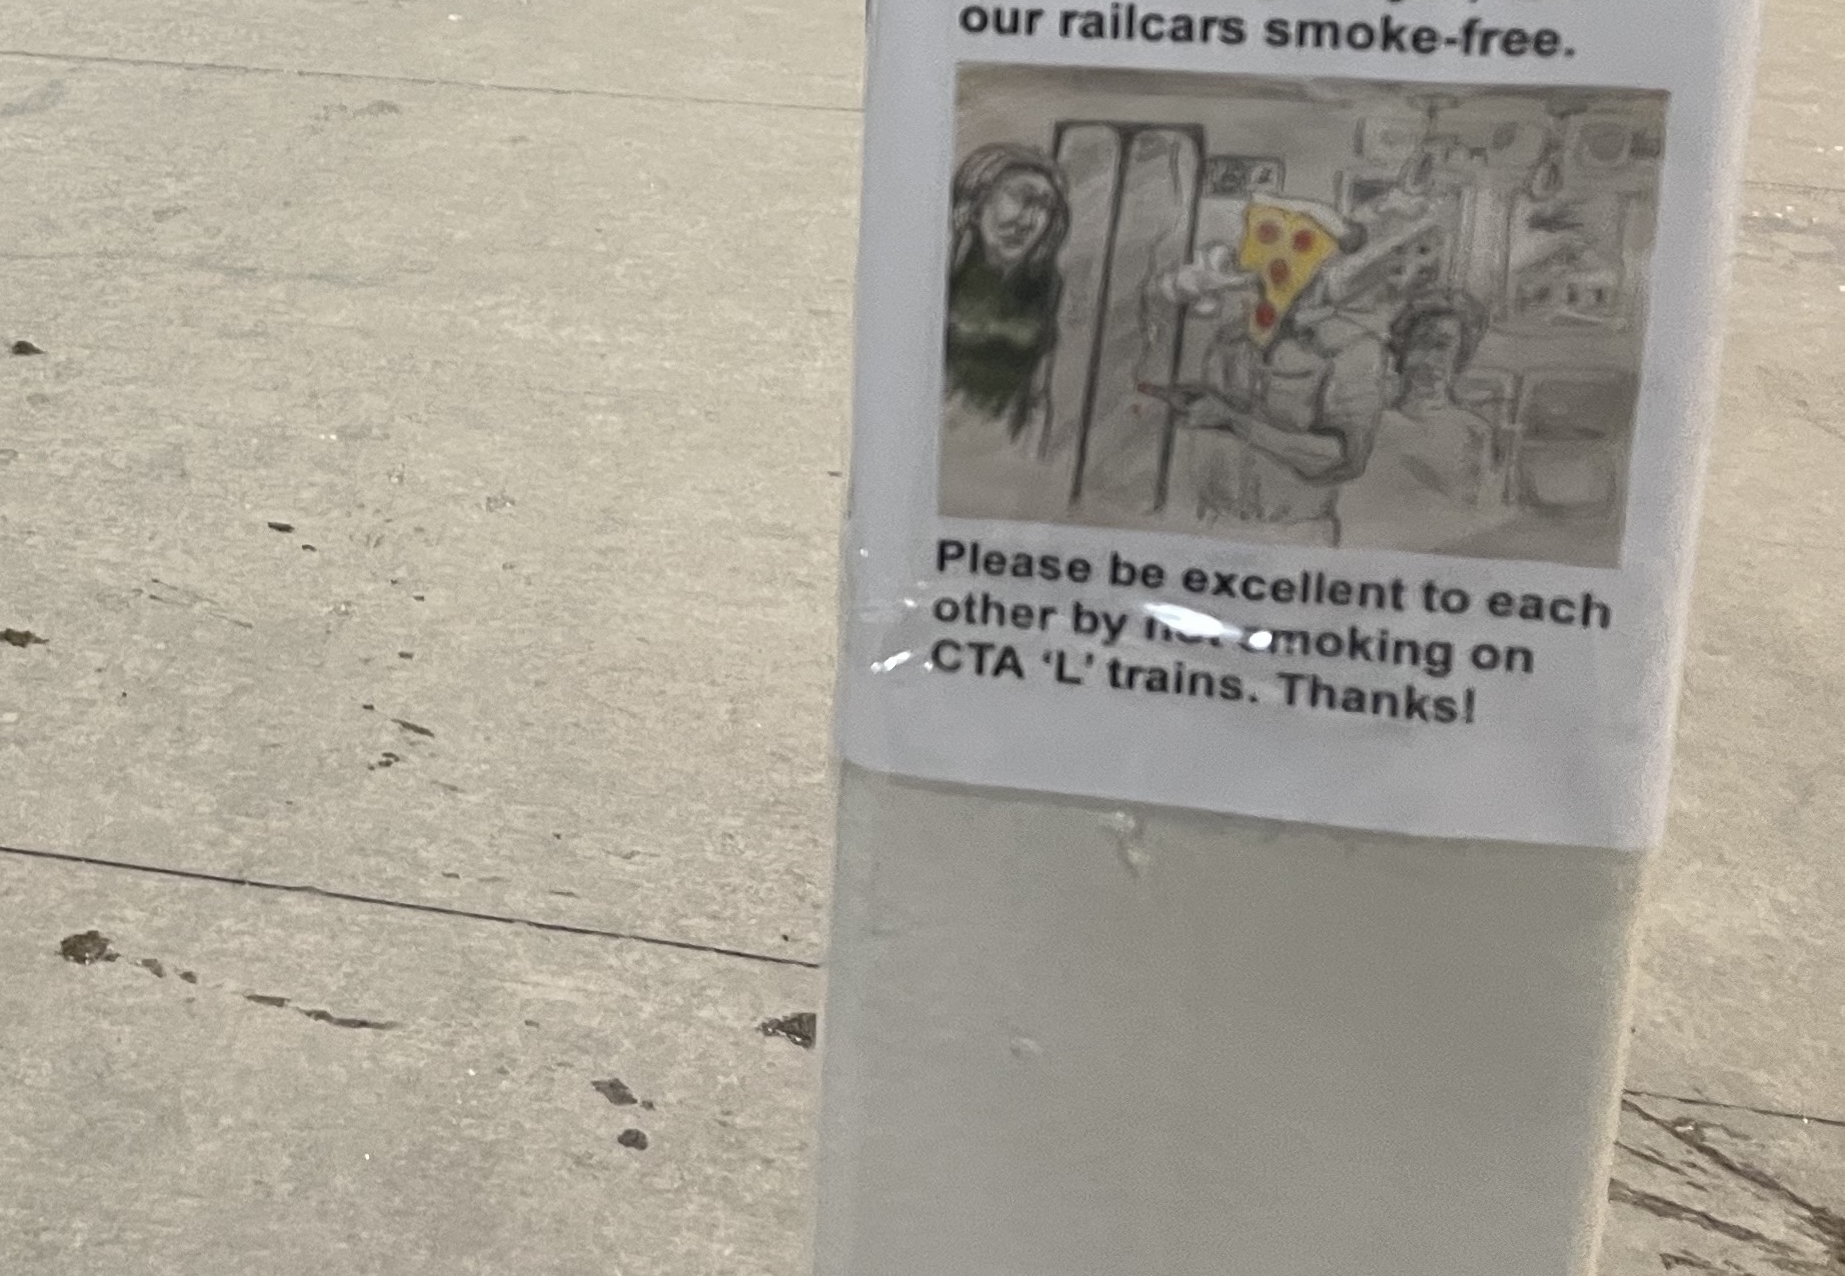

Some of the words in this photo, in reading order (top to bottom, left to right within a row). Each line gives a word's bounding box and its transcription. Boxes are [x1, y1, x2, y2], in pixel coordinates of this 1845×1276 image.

[958, 4, 1045, 37] our
[1059, 1, 1248, 46] railcars
[1264, 14, 1576, 58] smoke-free.
[937, 538, 1092, 583] Please
[1109, 550, 1166, 590] be
[1181, 566, 1407, 613] excellent
[1423, 579, 1471, 615] to
[1487, 592, 1612, 629] each
[933, 591, 1056, 632] other
[1072, 600, 1128, 646] by
[1470, 642, 1534, 674] on
[931, 638, 1024, 680] CTA
[1109, 658, 1259, 704] trains.
[1276, 670, 1476, 725] Thanks!
